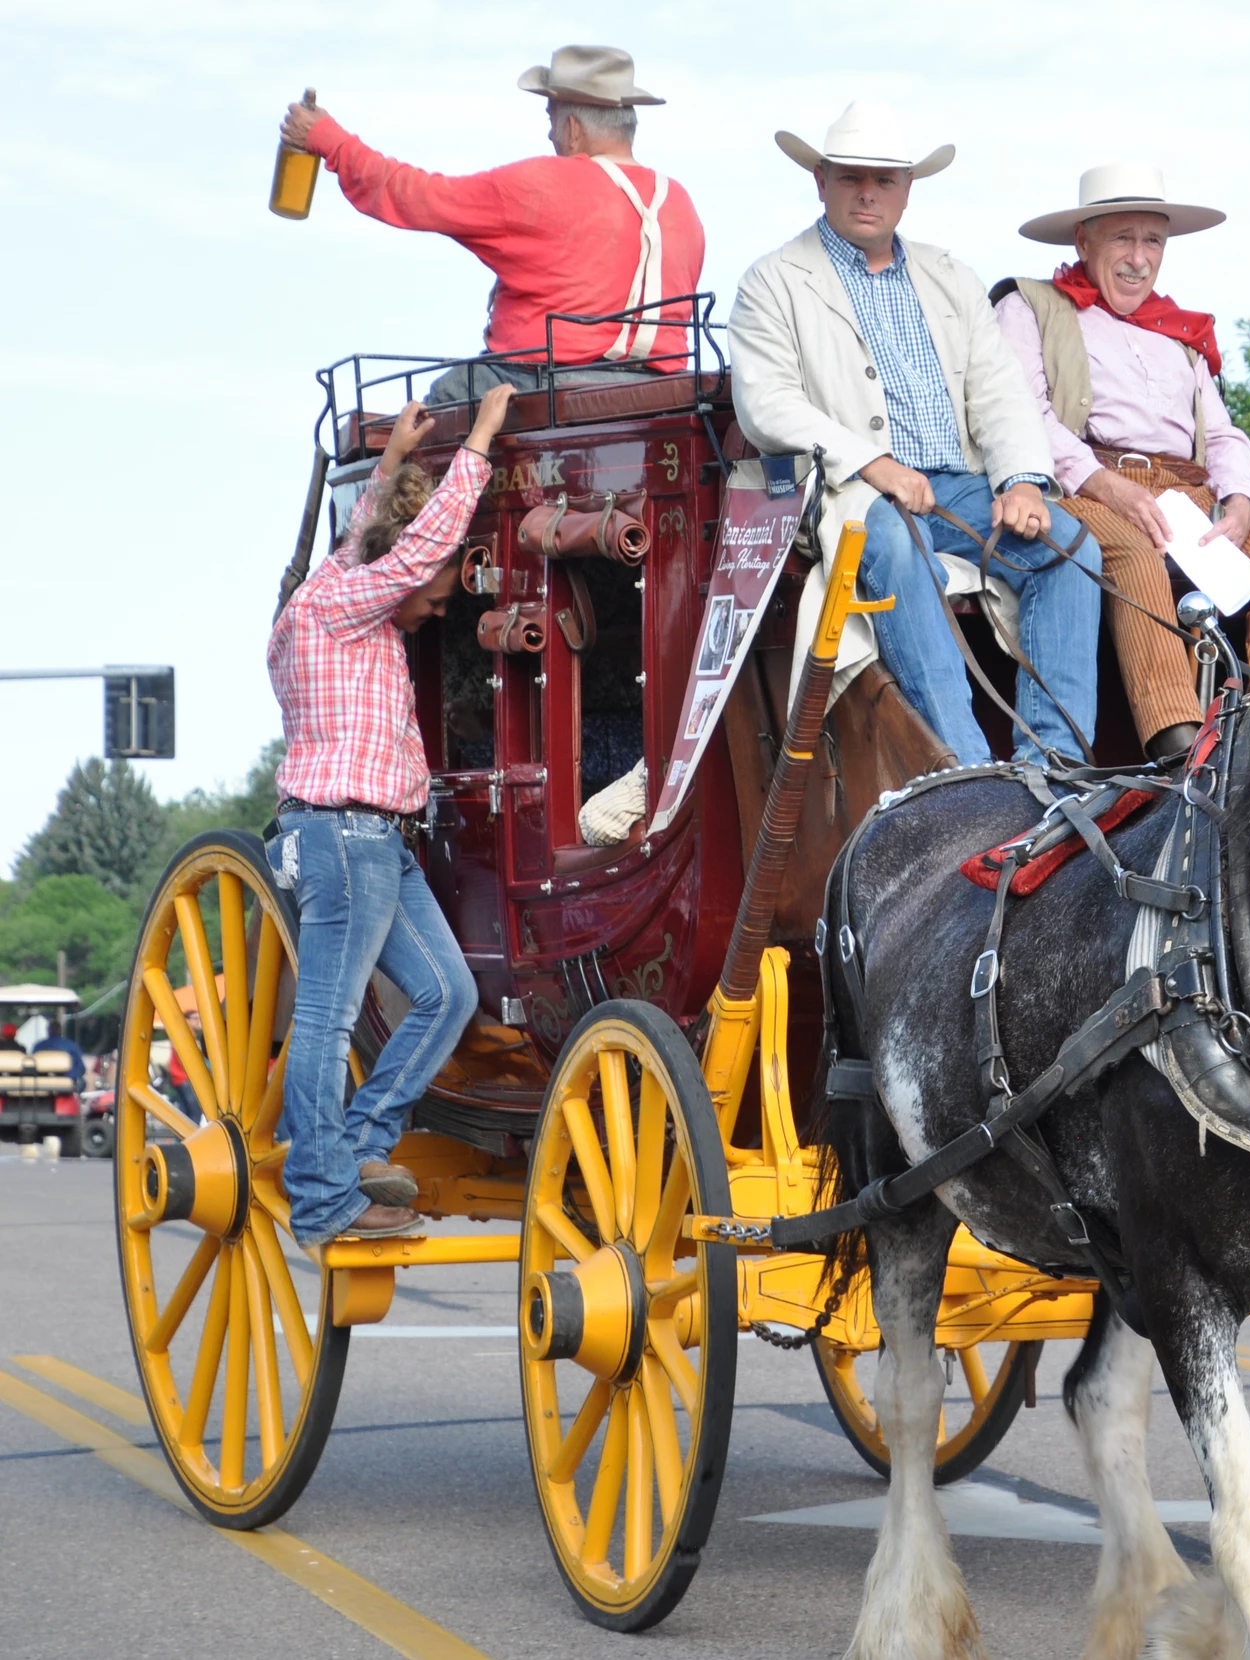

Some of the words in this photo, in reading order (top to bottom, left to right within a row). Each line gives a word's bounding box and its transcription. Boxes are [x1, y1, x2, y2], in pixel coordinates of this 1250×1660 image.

[493, 459, 565, 493] BANK
[722, 517, 776, 546] Centennial
[717, 548, 735, 579] Living
[736, 547, 770, 578] Heritage
